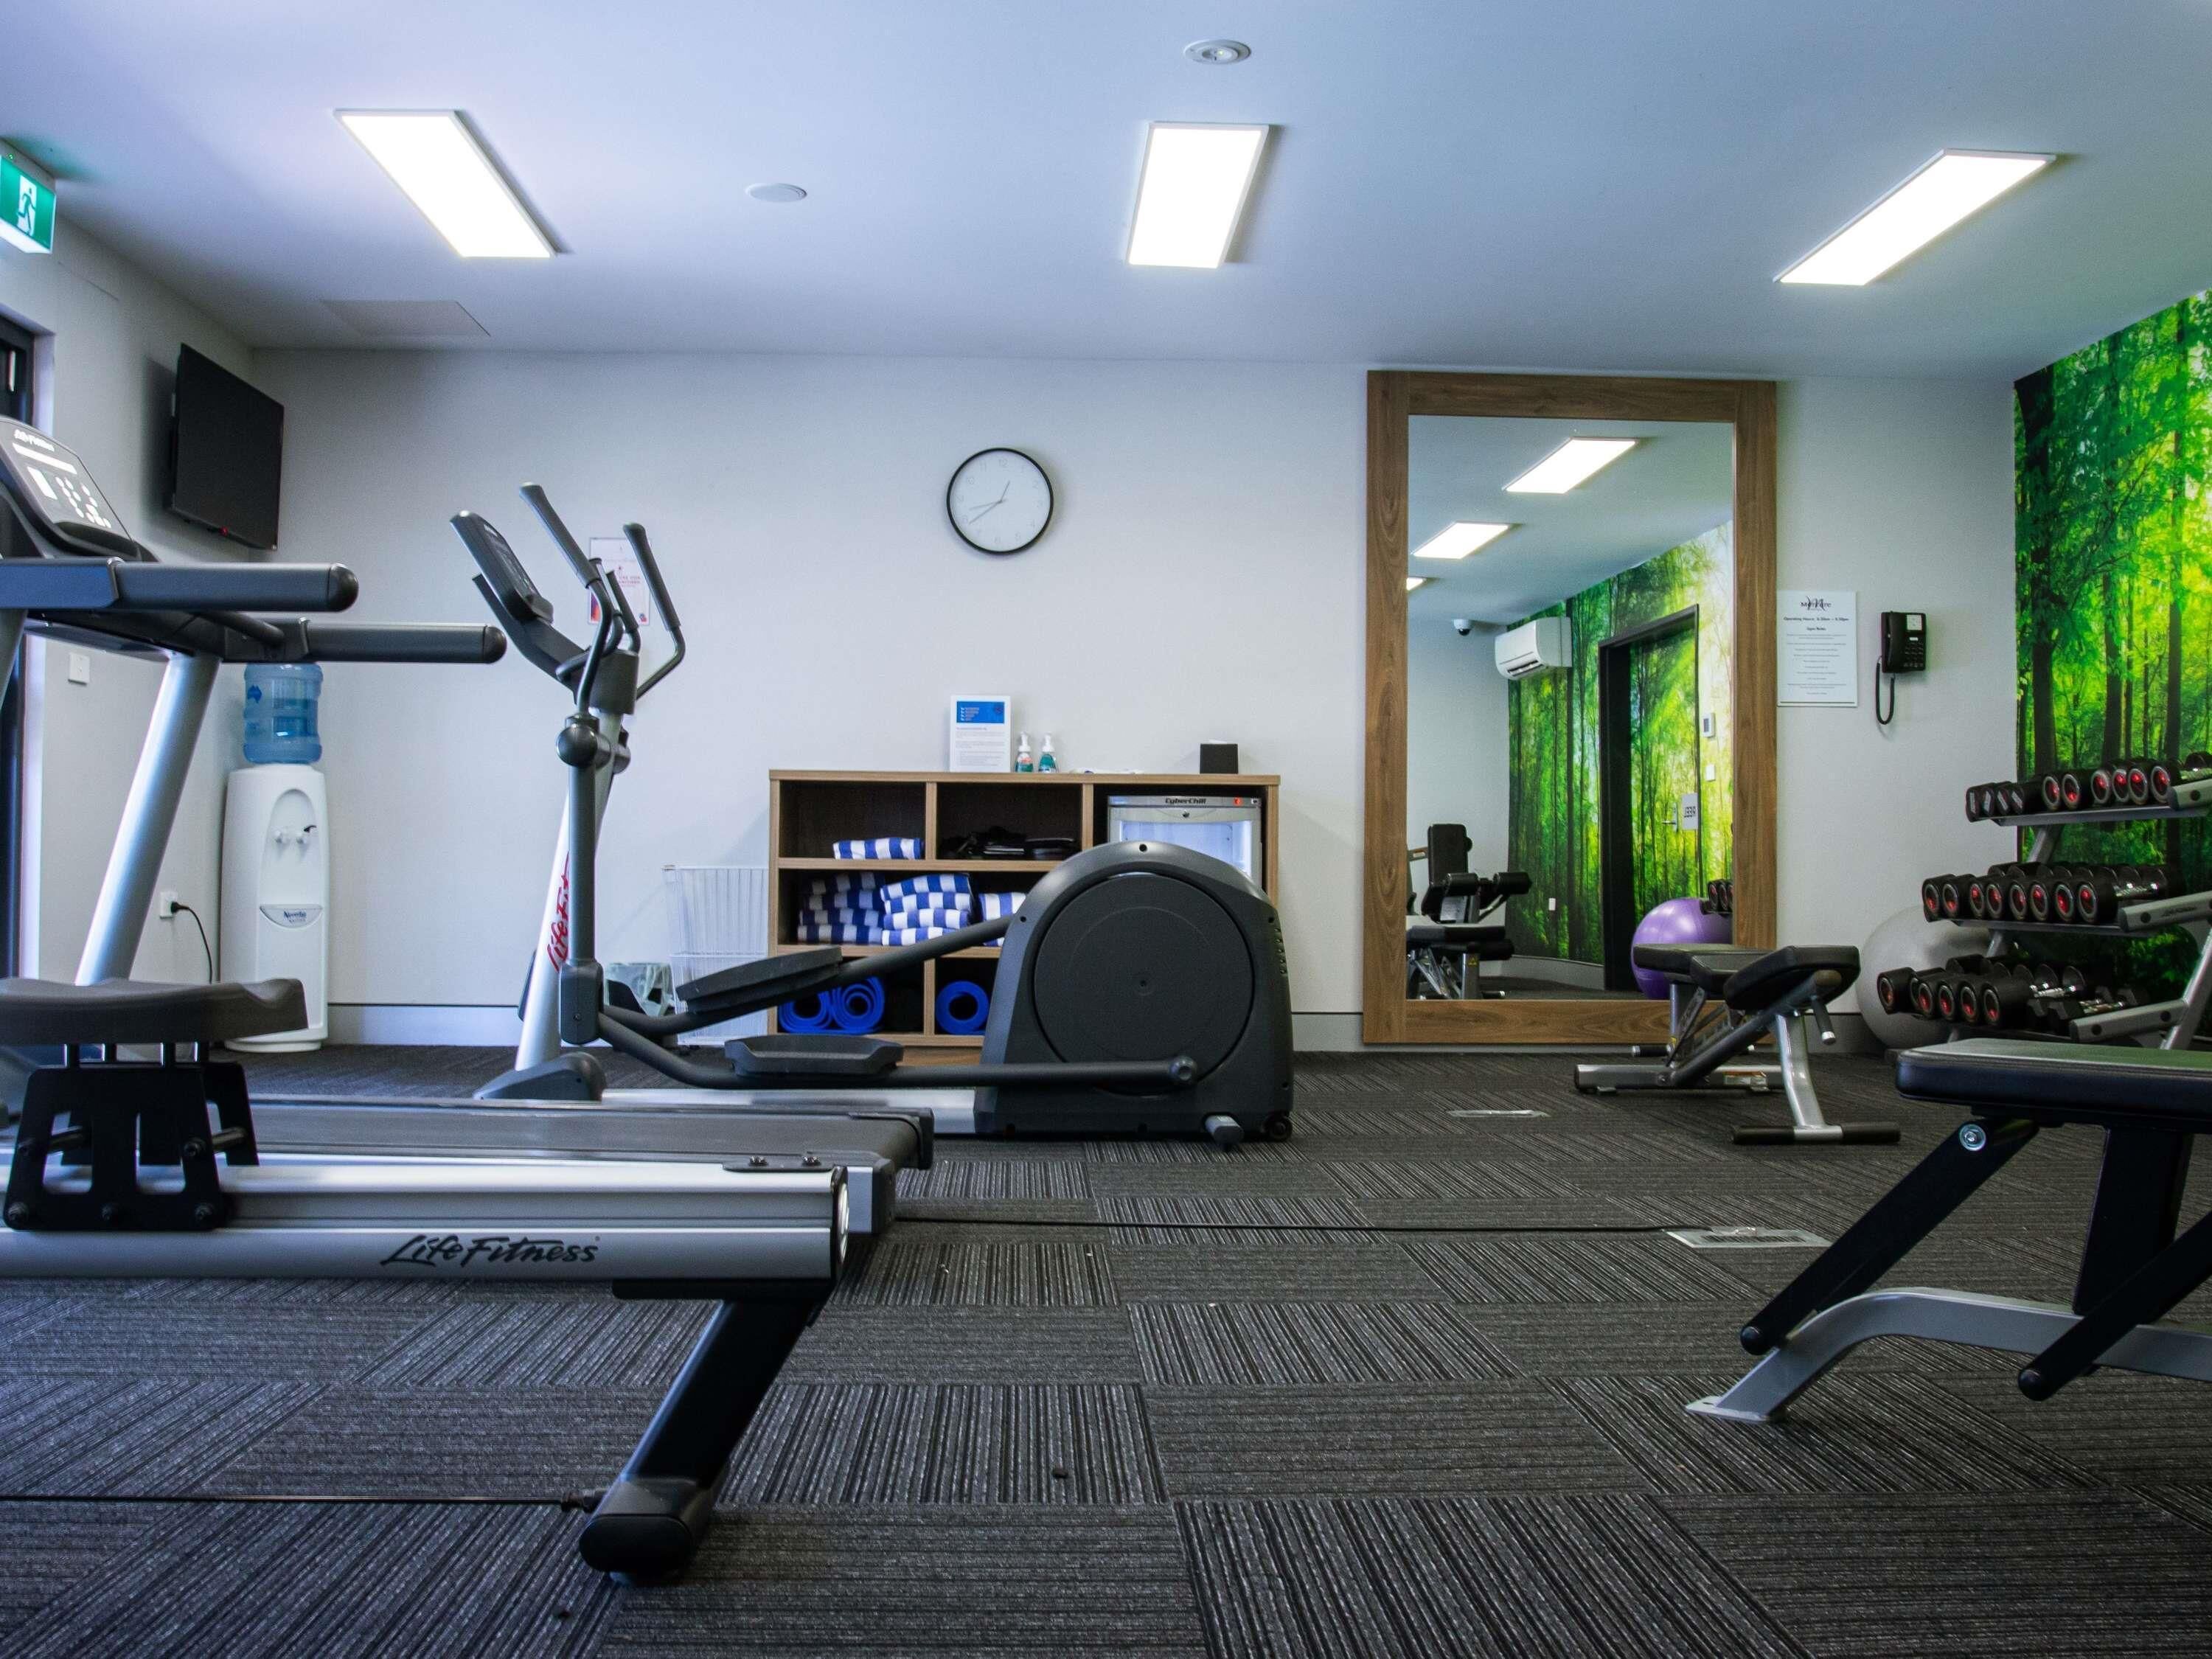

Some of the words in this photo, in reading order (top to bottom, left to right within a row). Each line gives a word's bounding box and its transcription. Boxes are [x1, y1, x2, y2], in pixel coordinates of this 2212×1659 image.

[998, 458, 1009, 468] 12
[380, 1234, 463, 1266] Life
[460, 1236, 599, 1267] Fitness
